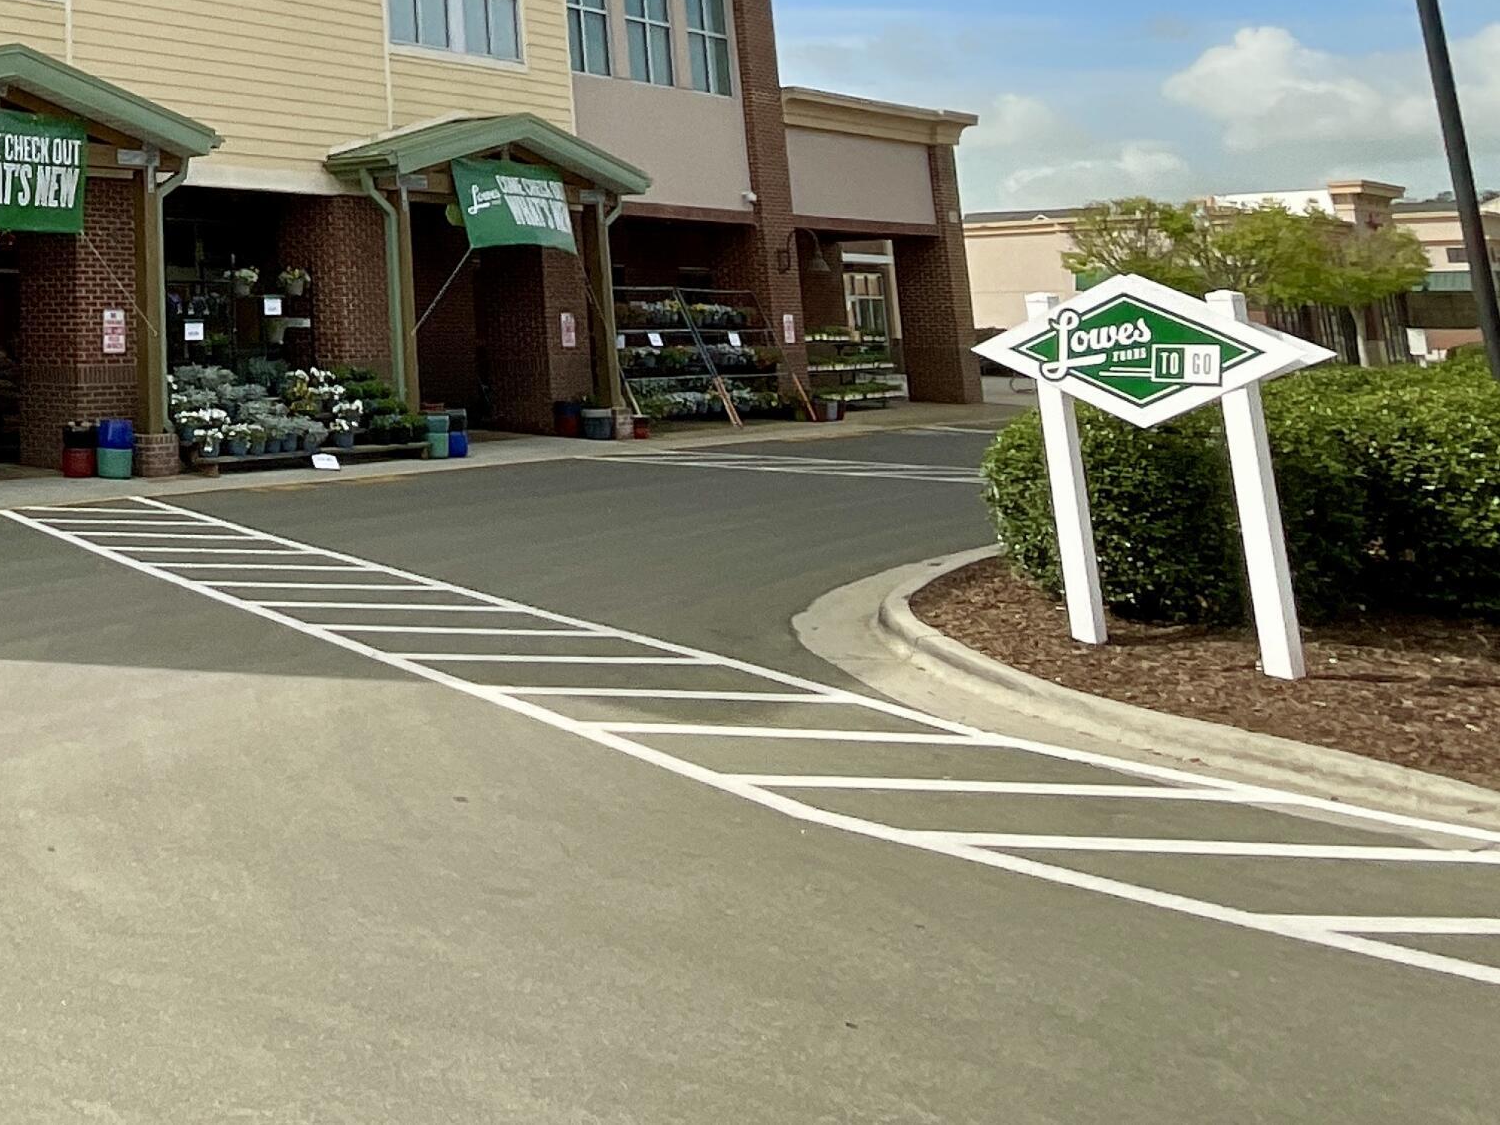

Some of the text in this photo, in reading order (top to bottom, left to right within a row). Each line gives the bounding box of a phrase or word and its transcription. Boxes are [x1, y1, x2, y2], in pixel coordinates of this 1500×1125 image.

[4, 134, 49, 164] CHECK
[52, 138, 82, 166] OUT
[34, 165, 80, 209] NEW
[1040, 309, 1152, 380] Lowes
[1160, 352, 1212, 375] TO GO
